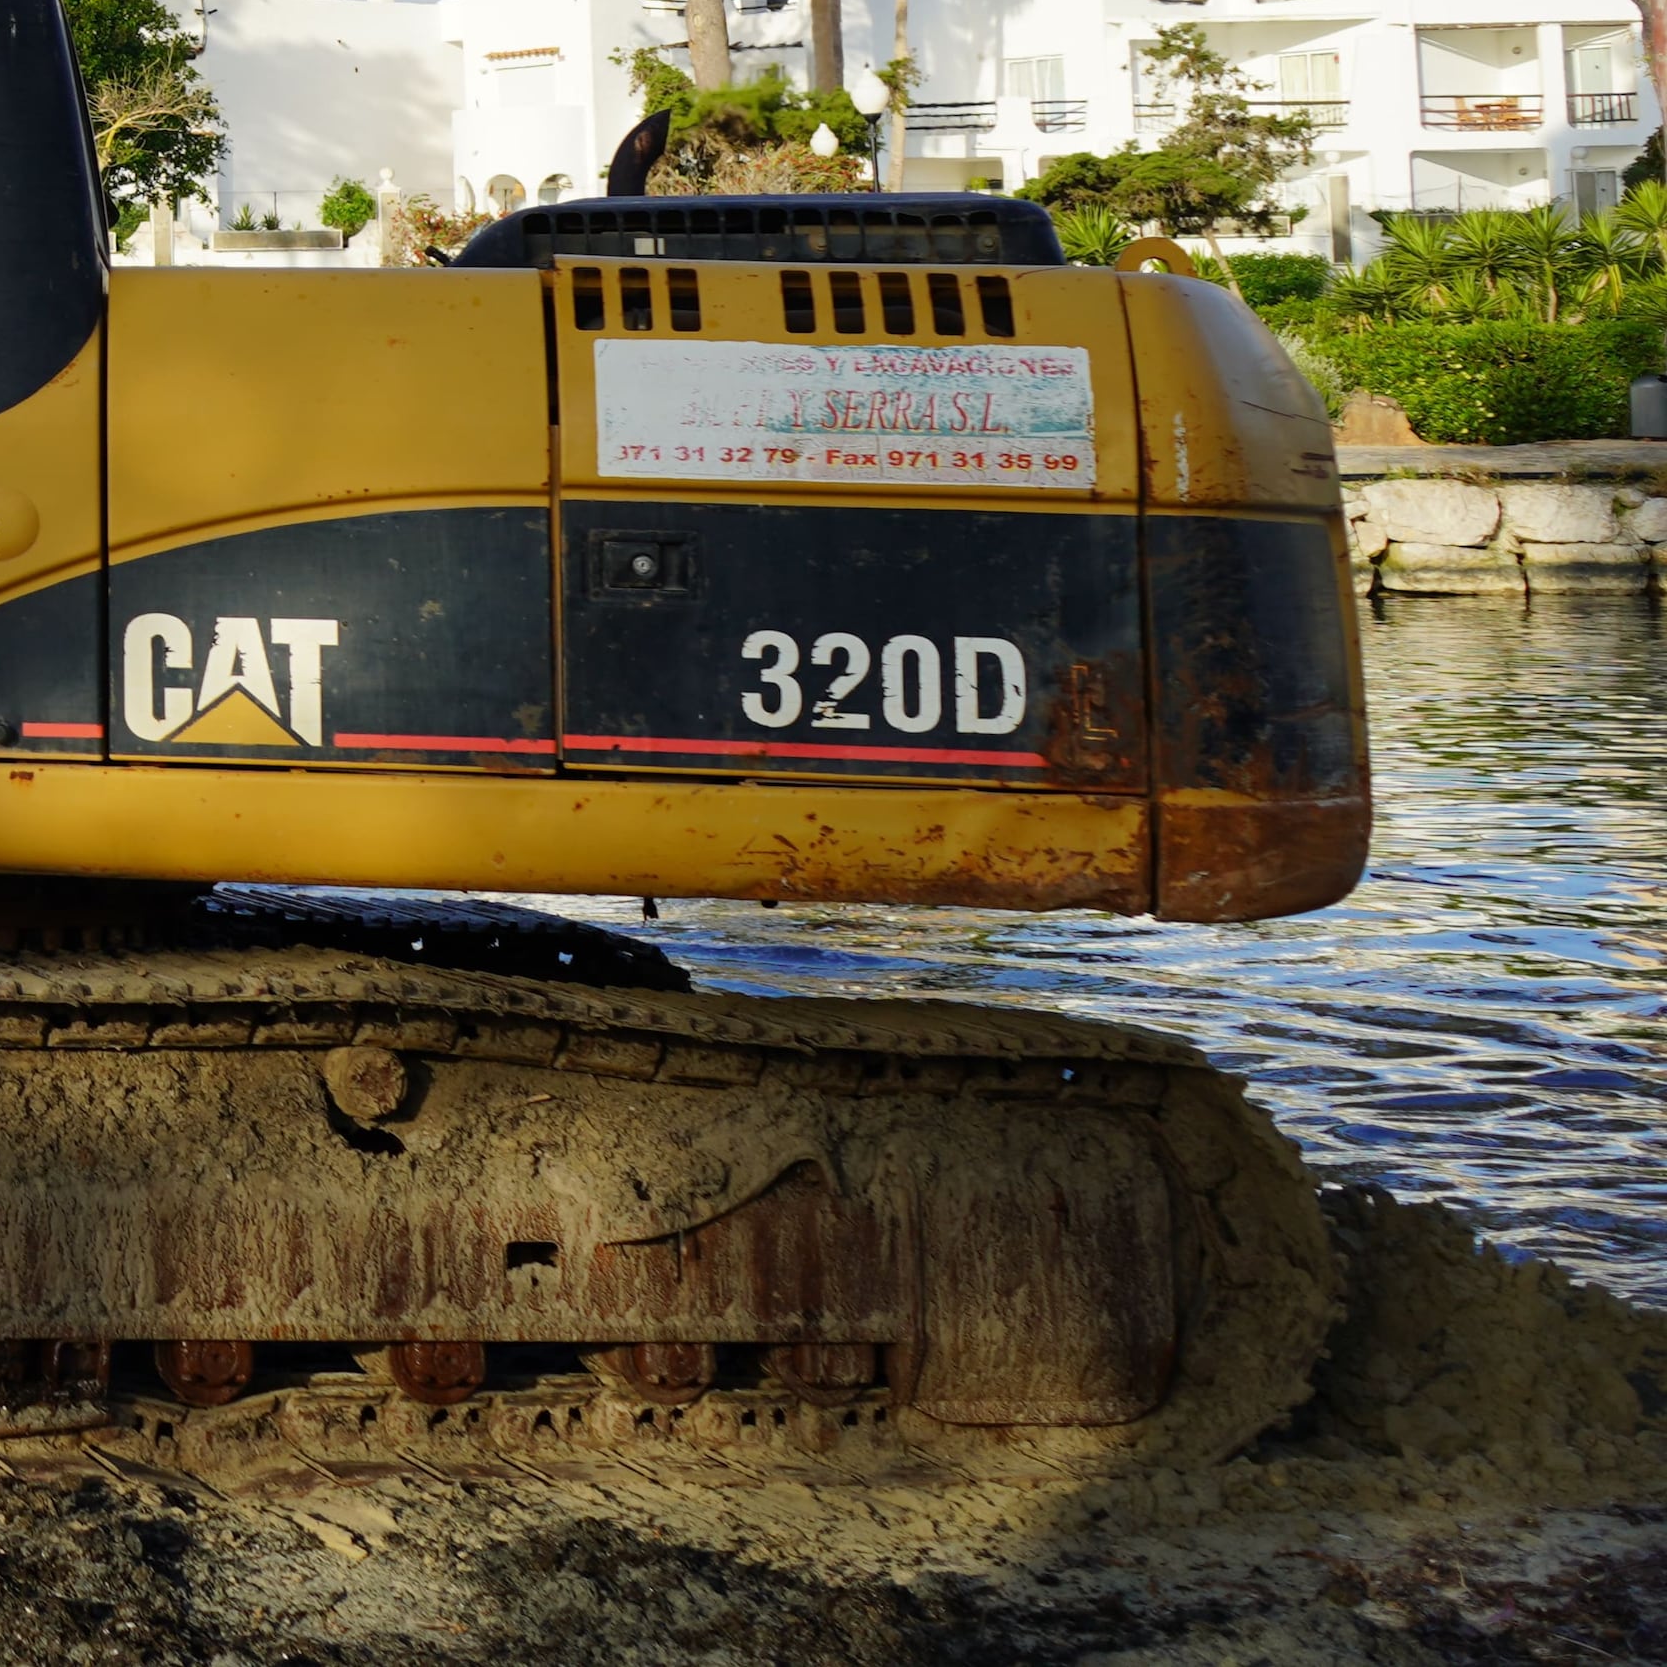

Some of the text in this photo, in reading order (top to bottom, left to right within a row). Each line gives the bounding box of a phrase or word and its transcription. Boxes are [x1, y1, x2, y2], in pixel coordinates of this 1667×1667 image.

[820, 389, 944, 431] SERRA
[949, 391, 1010, 433] S.L.
[673, 446, 705, 462] 31
[719, 446, 754, 463] 32
[763, 447, 797, 465] 79
[826, 449, 877, 466] Fax
[887, 450, 939, 467] 971
[951, 451, 985, 468] 31
[997, 453, 1033, 469] 35
[1043, 454, 1079, 471] 99
[123, 612, 340, 747] CAT
[741, 629, 1027, 735] 320D
